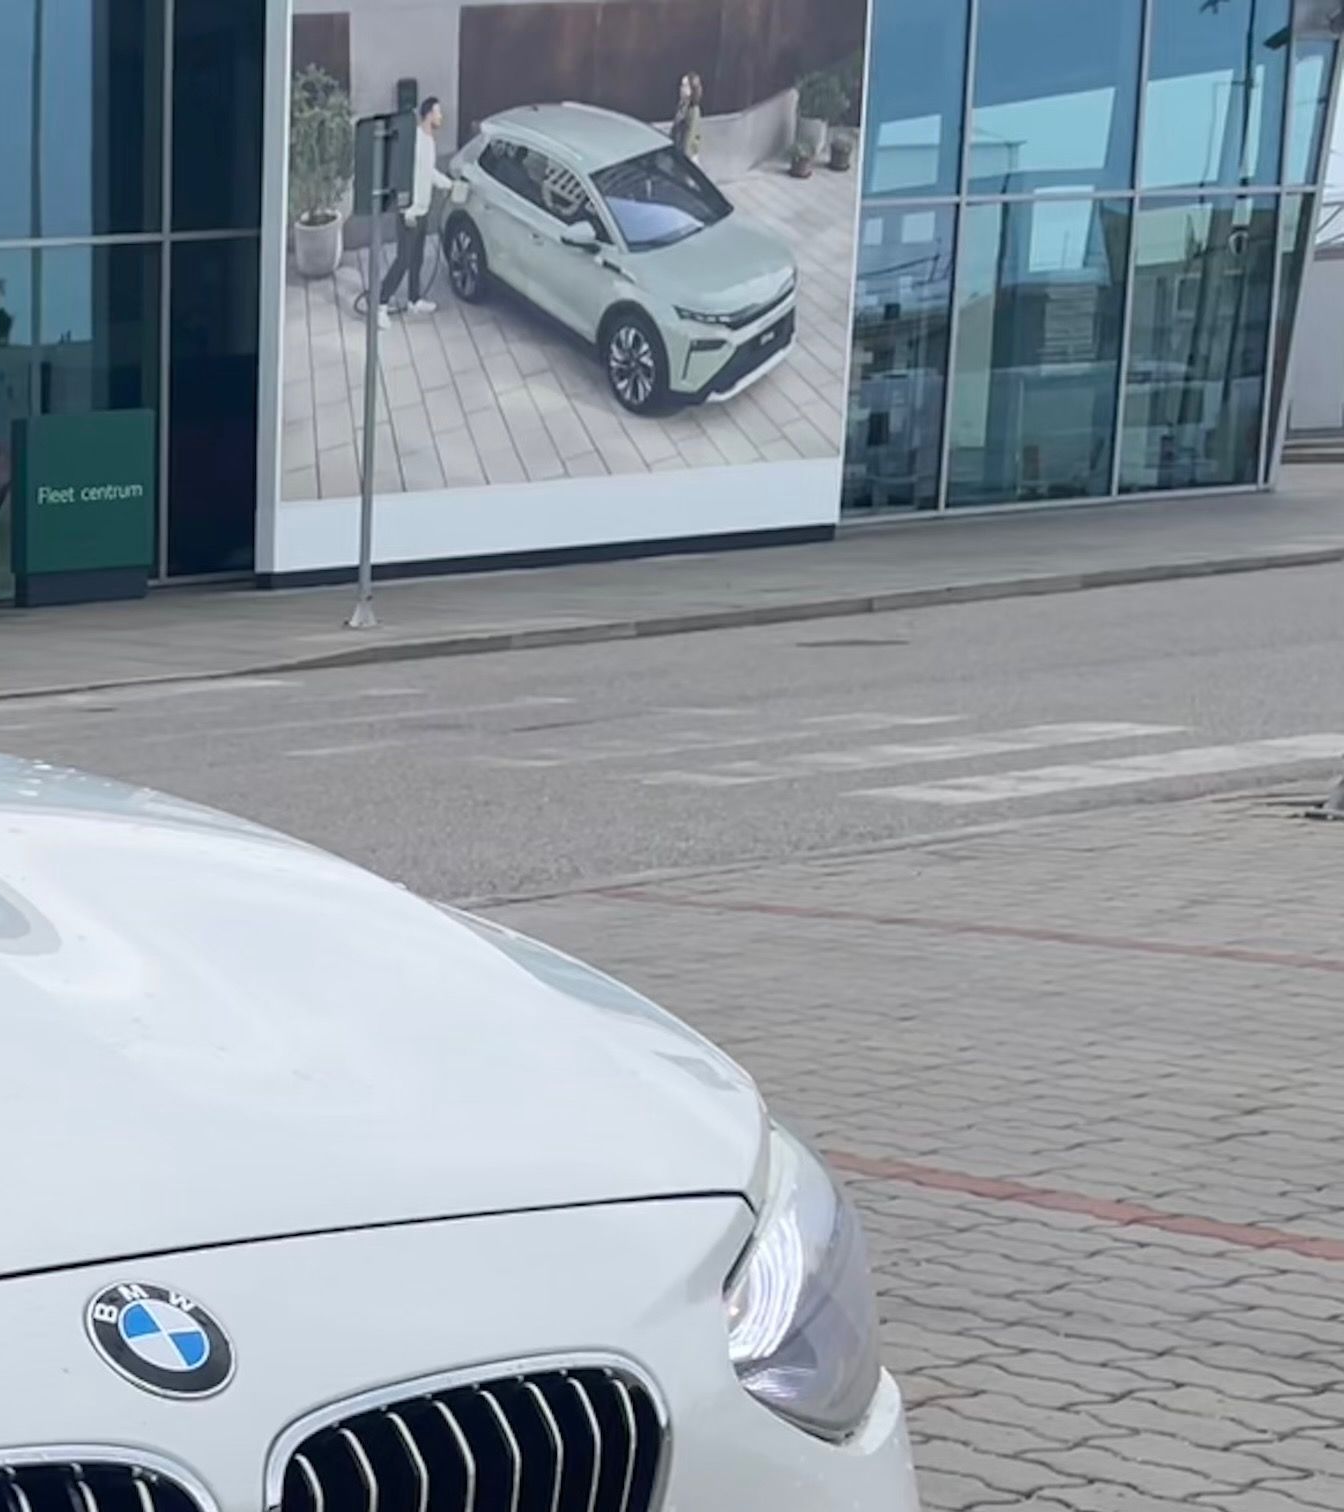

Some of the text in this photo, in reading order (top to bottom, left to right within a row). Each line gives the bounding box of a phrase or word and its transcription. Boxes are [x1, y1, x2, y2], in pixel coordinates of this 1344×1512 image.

[37, 483, 144, 505] Fleet centrum
[93, 1283, 197, 1325] BMW
